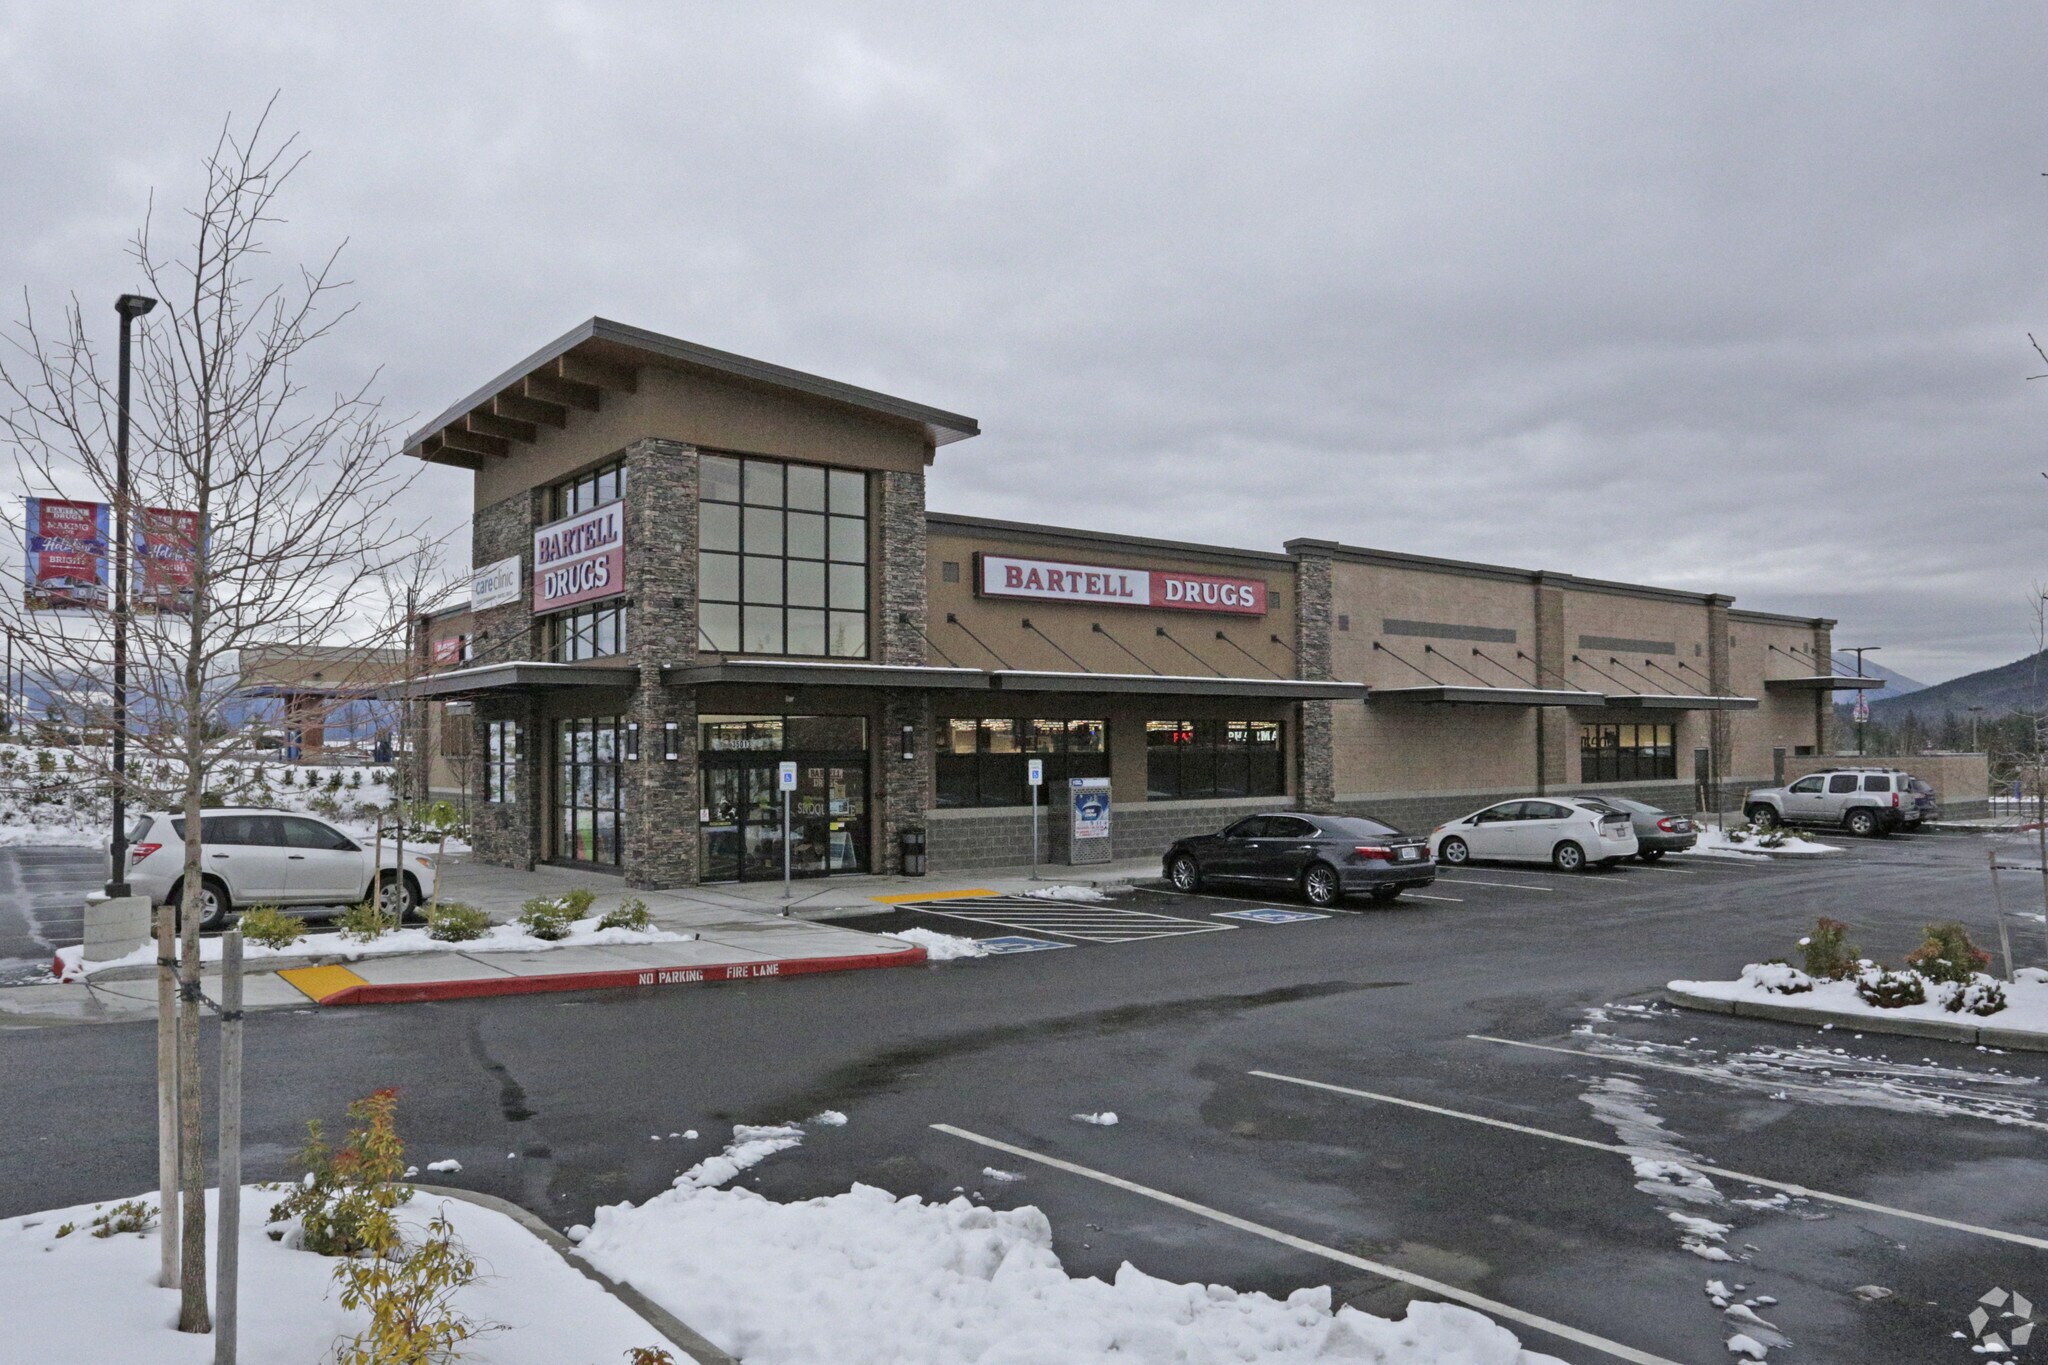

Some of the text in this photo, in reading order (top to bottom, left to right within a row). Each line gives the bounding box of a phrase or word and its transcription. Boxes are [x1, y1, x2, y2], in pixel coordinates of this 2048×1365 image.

[538, 513, 618, 565] BARTELL
[544, 555, 609, 600] DRUGS
[1005, 565, 1255, 607] BARTELL DRUGS
[639, 963, 779, 985] NO PARKING FIRE LANE
